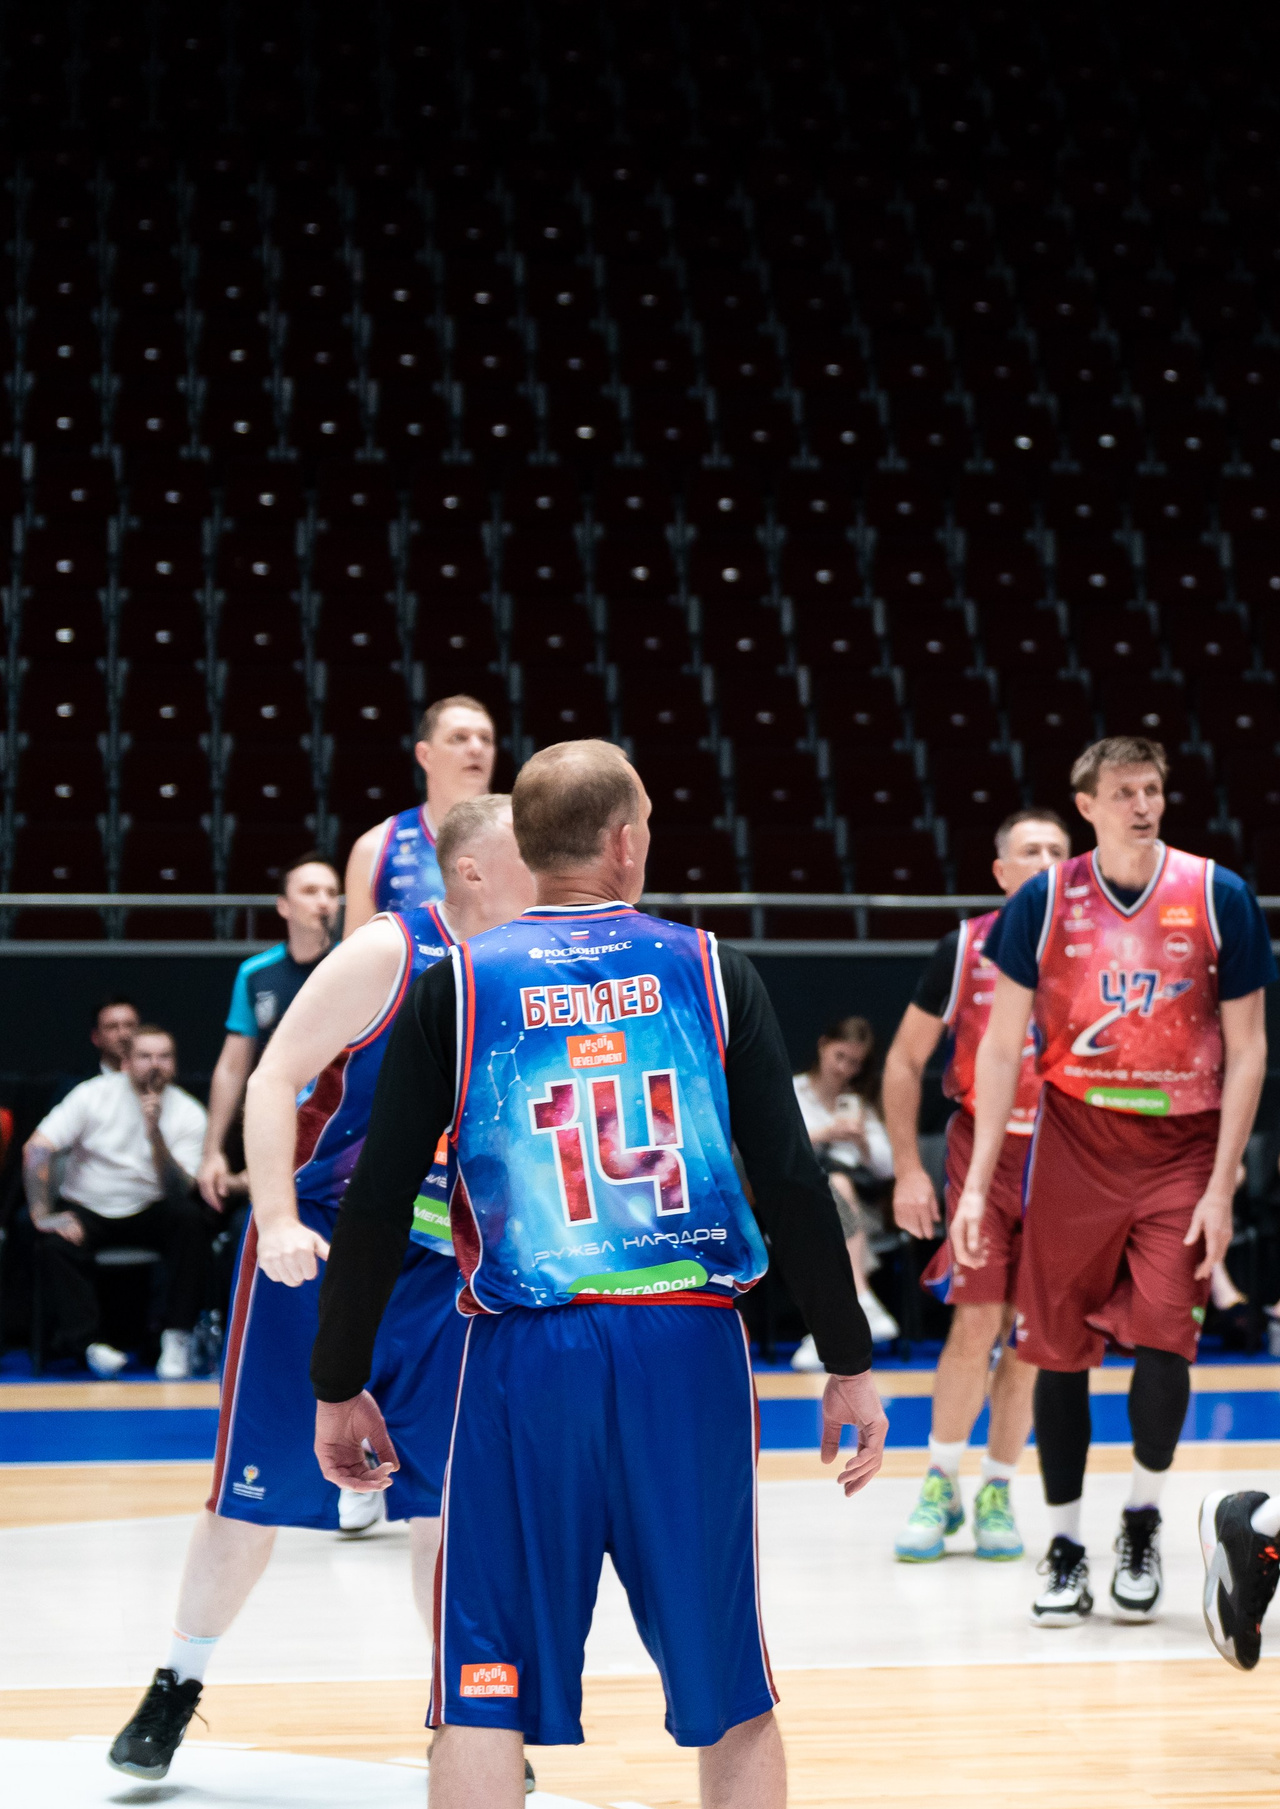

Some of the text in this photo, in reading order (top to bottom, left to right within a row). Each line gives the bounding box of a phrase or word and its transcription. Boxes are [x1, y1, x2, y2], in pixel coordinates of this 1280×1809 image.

[544, 940, 632, 957] РОСКОНГРЕСС
[521, 975, 661, 1029] БЕЛЯЕВ
[1099, 970, 1160, 1016] 47
[579, 1035, 614, 1054] VYSOTA
[573, 1052, 622, 1067] DEVELOPMENT
[527, 1069, 690, 1227] 14
[534, 1228, 728, 1264] РУЖБА НАРОДОВ
[473, 1665, 507, 1683] VYSOTA
[464, 1685, 514, 1695] DEVELOPMENT
